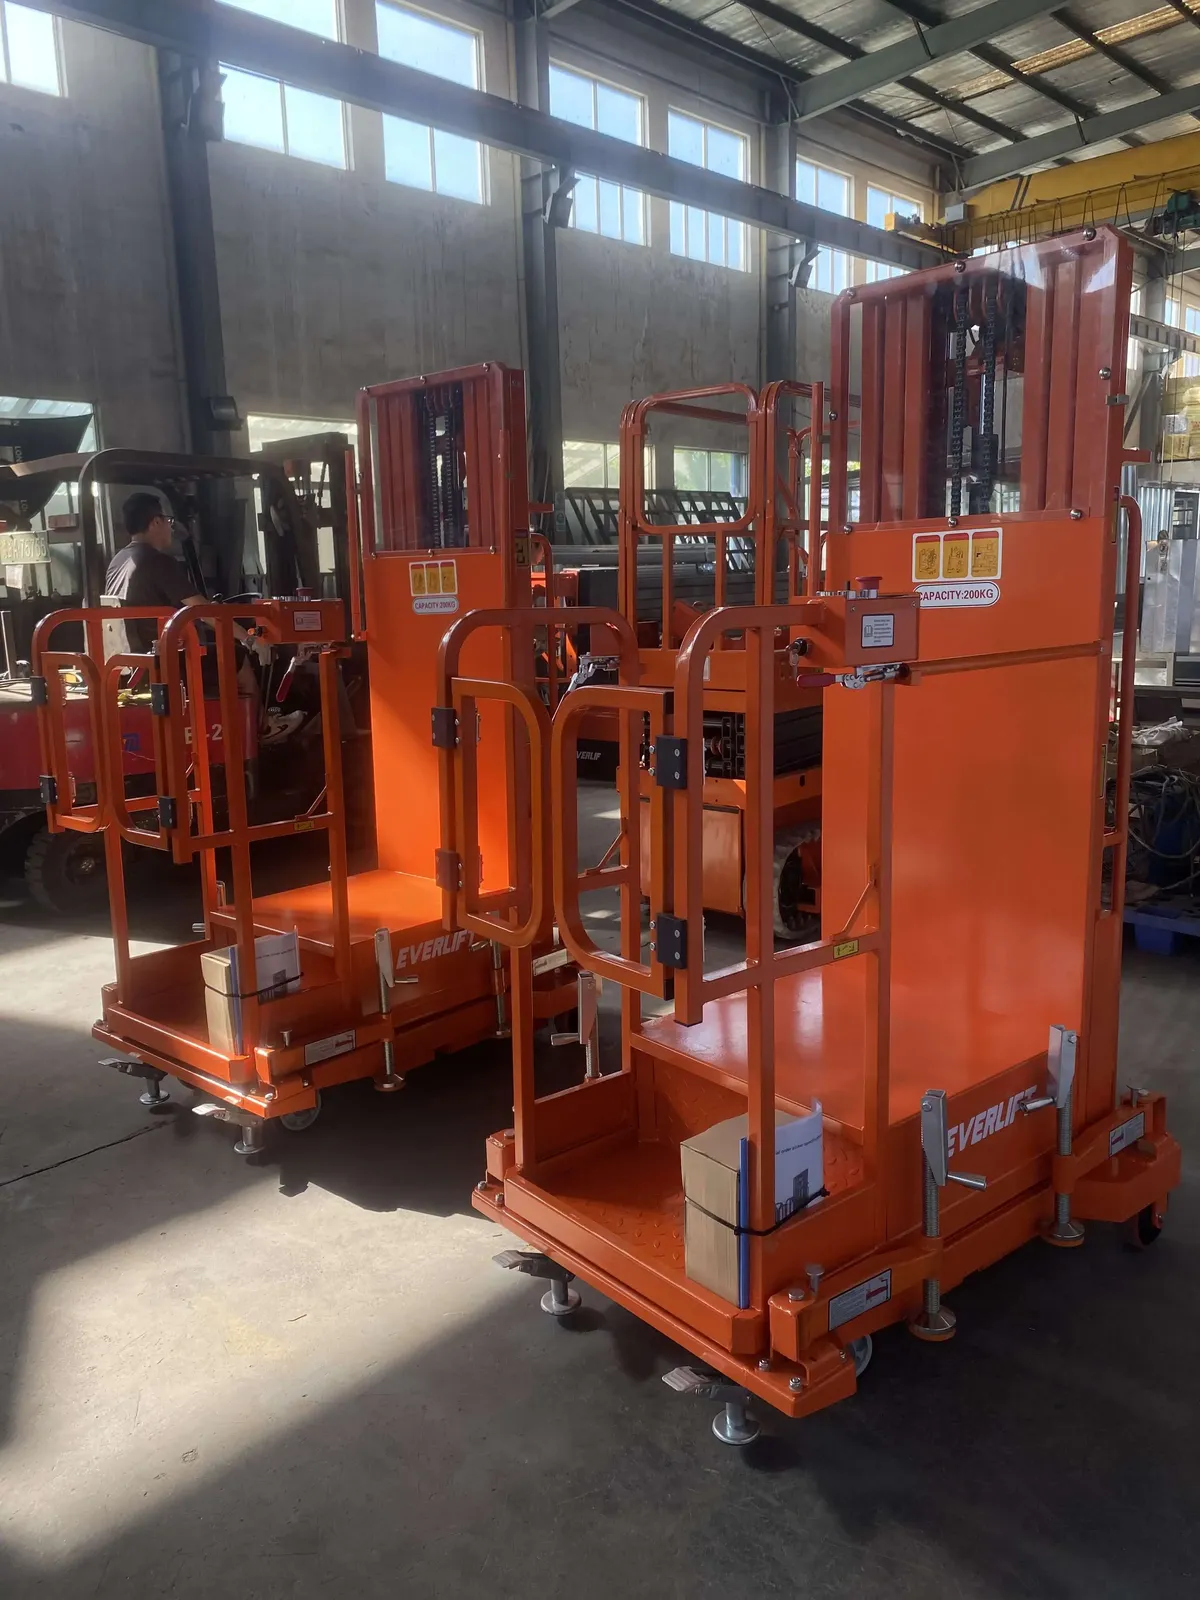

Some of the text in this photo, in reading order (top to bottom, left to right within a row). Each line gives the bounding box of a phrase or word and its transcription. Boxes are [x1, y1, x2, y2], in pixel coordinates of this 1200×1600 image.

[576, 750, 602, 761] VERLIF
[396, 928, 475, 970] EVERLIFT
[947, 1084, 1037, 1158] EVERLIFT
